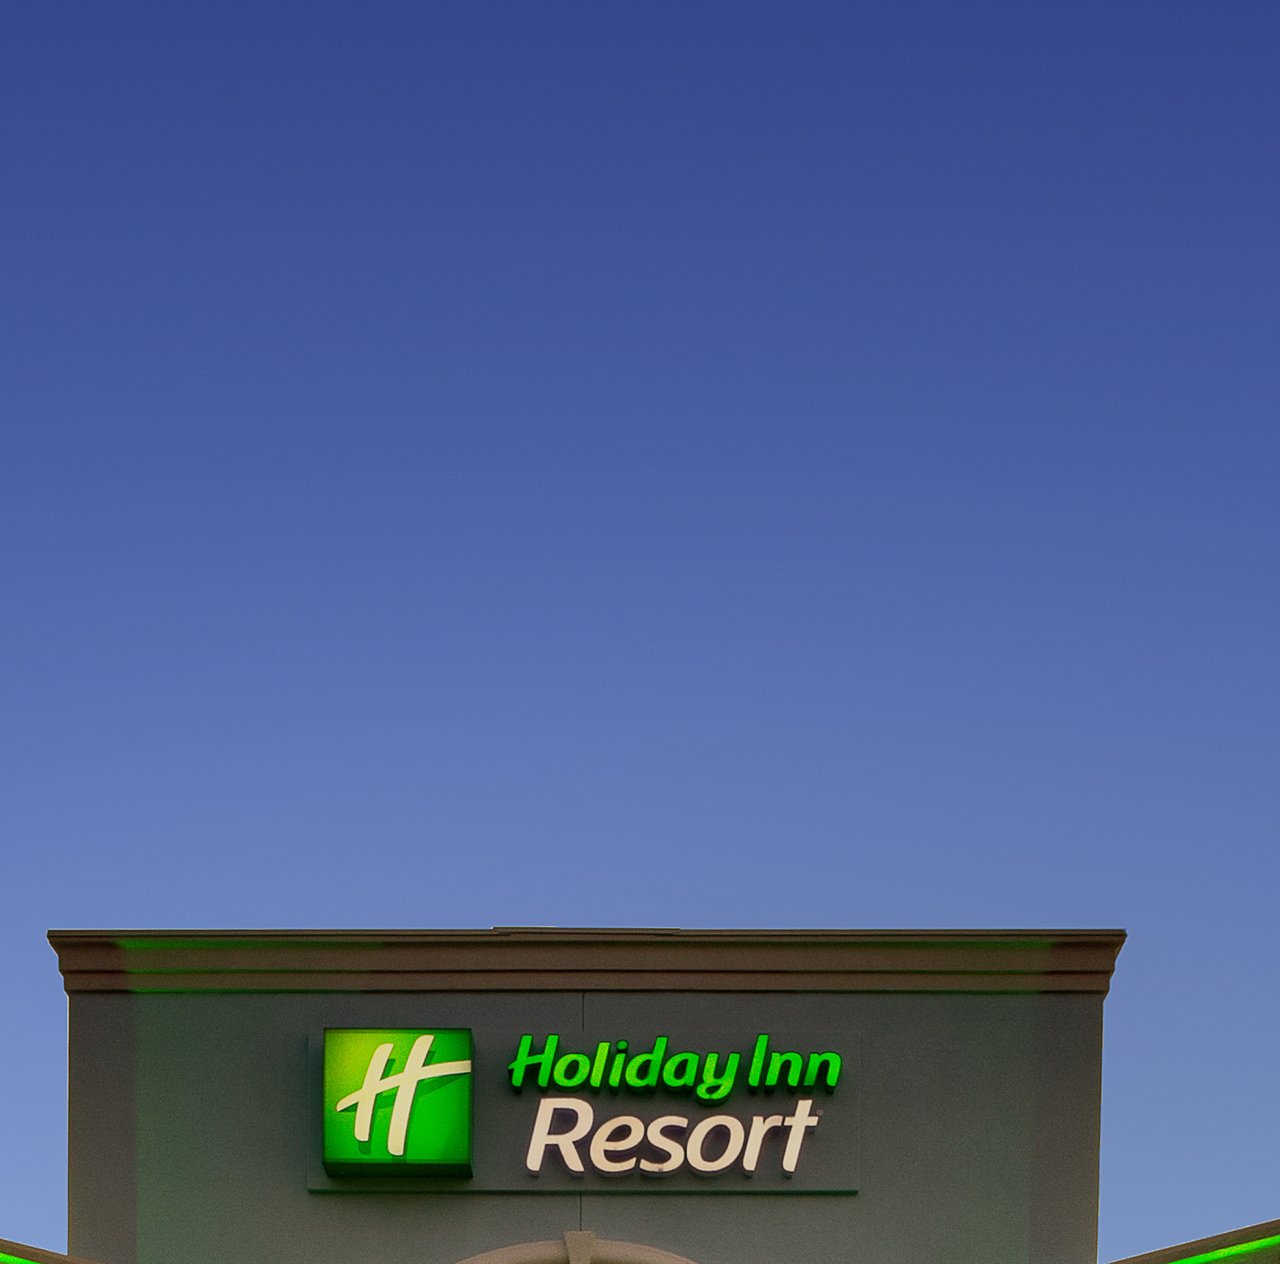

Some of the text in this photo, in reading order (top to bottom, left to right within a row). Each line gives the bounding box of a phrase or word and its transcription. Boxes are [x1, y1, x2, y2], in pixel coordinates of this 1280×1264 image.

[508, 1033, 842, 1100] Holiday Inn
[525, 1097, 819, 1175] Resort
